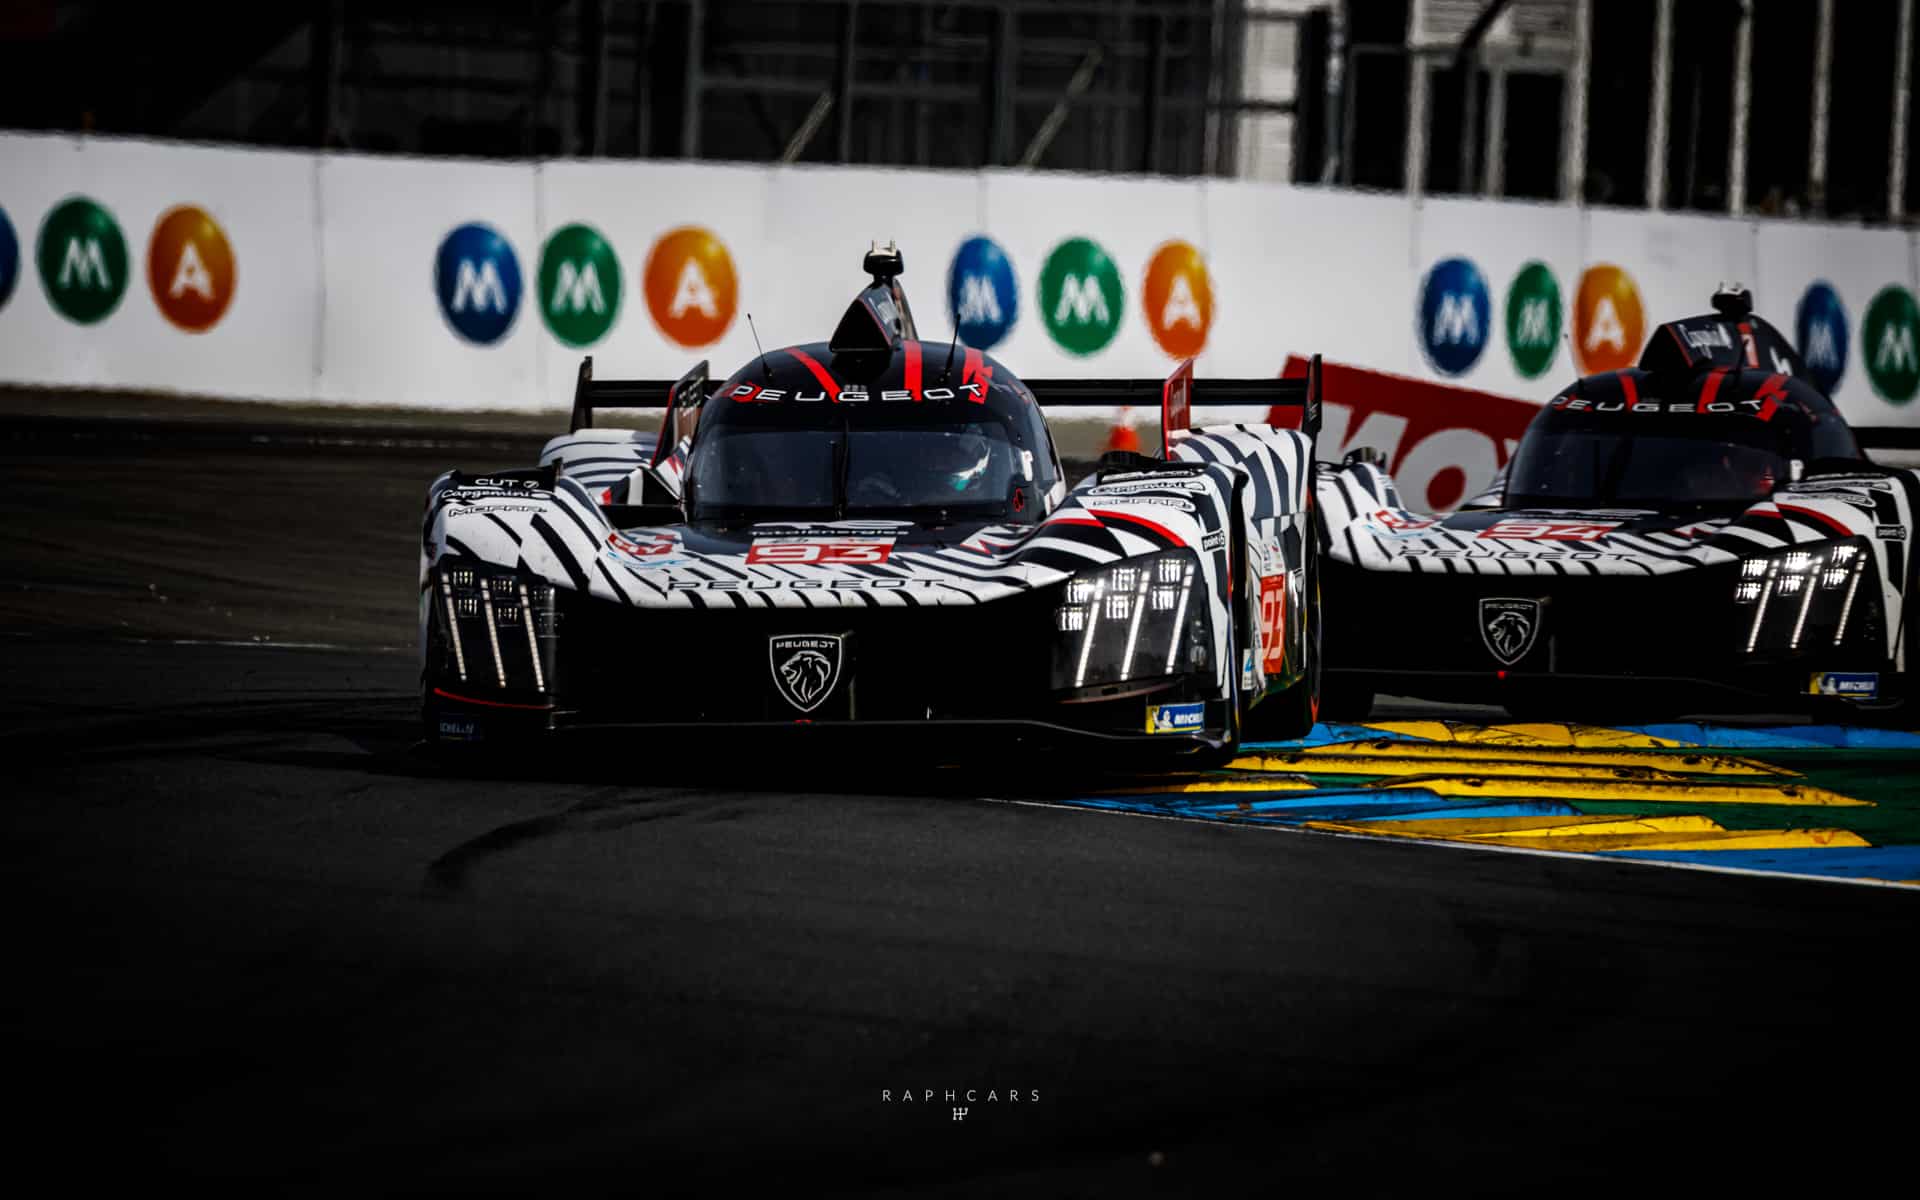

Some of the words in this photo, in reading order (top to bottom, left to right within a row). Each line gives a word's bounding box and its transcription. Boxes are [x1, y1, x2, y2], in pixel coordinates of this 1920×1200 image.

[729, 383, 983, 402] PEUGEOT
[1312, 400, 1521, 518] MO
[441, 488, 529, 499] Capgemini
[1487, 525, 1603, 539] 94
[754, 545, 883, 562] 93
[1399, 549, 1637, 561] PEUGEOT
[668, 579, 945, 590] PEUGEOT
[1262, 588, 1284, 660] 93
[776, 640, 836, 649] PEUGEOT
